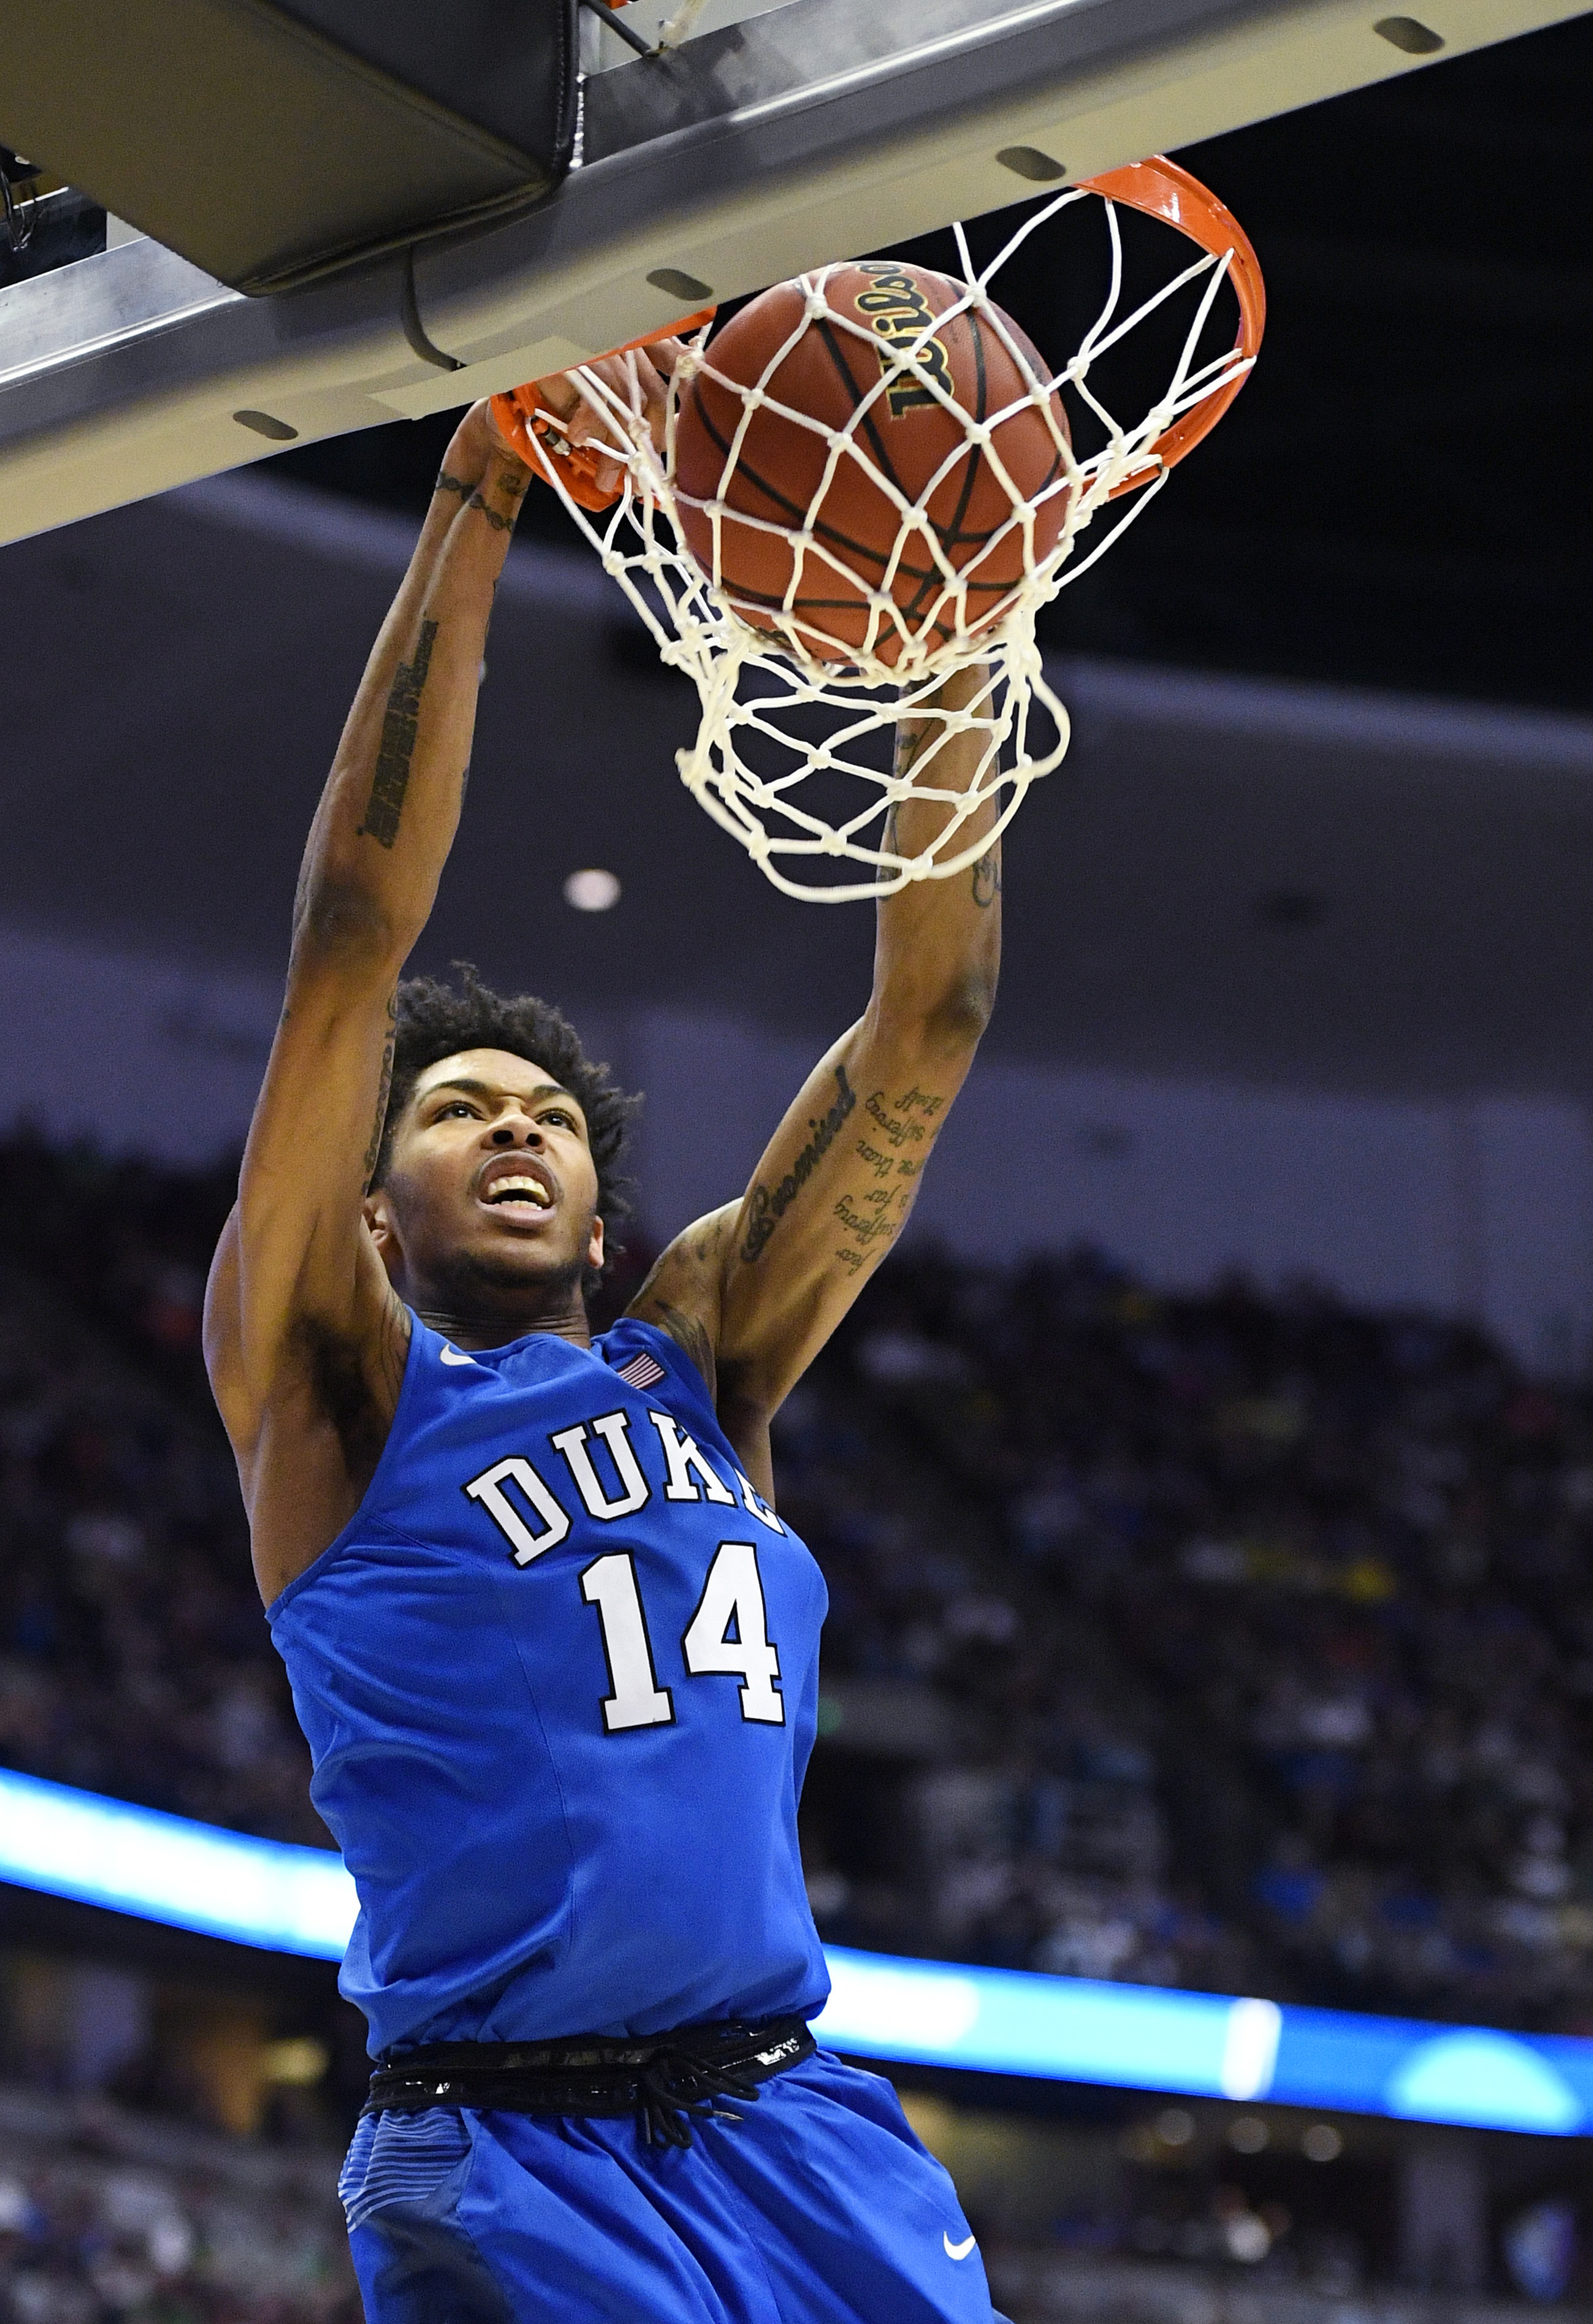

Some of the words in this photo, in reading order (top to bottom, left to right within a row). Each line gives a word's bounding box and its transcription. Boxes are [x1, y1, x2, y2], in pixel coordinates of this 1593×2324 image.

[854, 263, 955, 420] Wilso
[865, 1091, 926, 1147] suffering
[856, 1140, 894, 1179] than
[864, 1184, 902, 1215] far
[578, 1539, 786, 1736] 14
